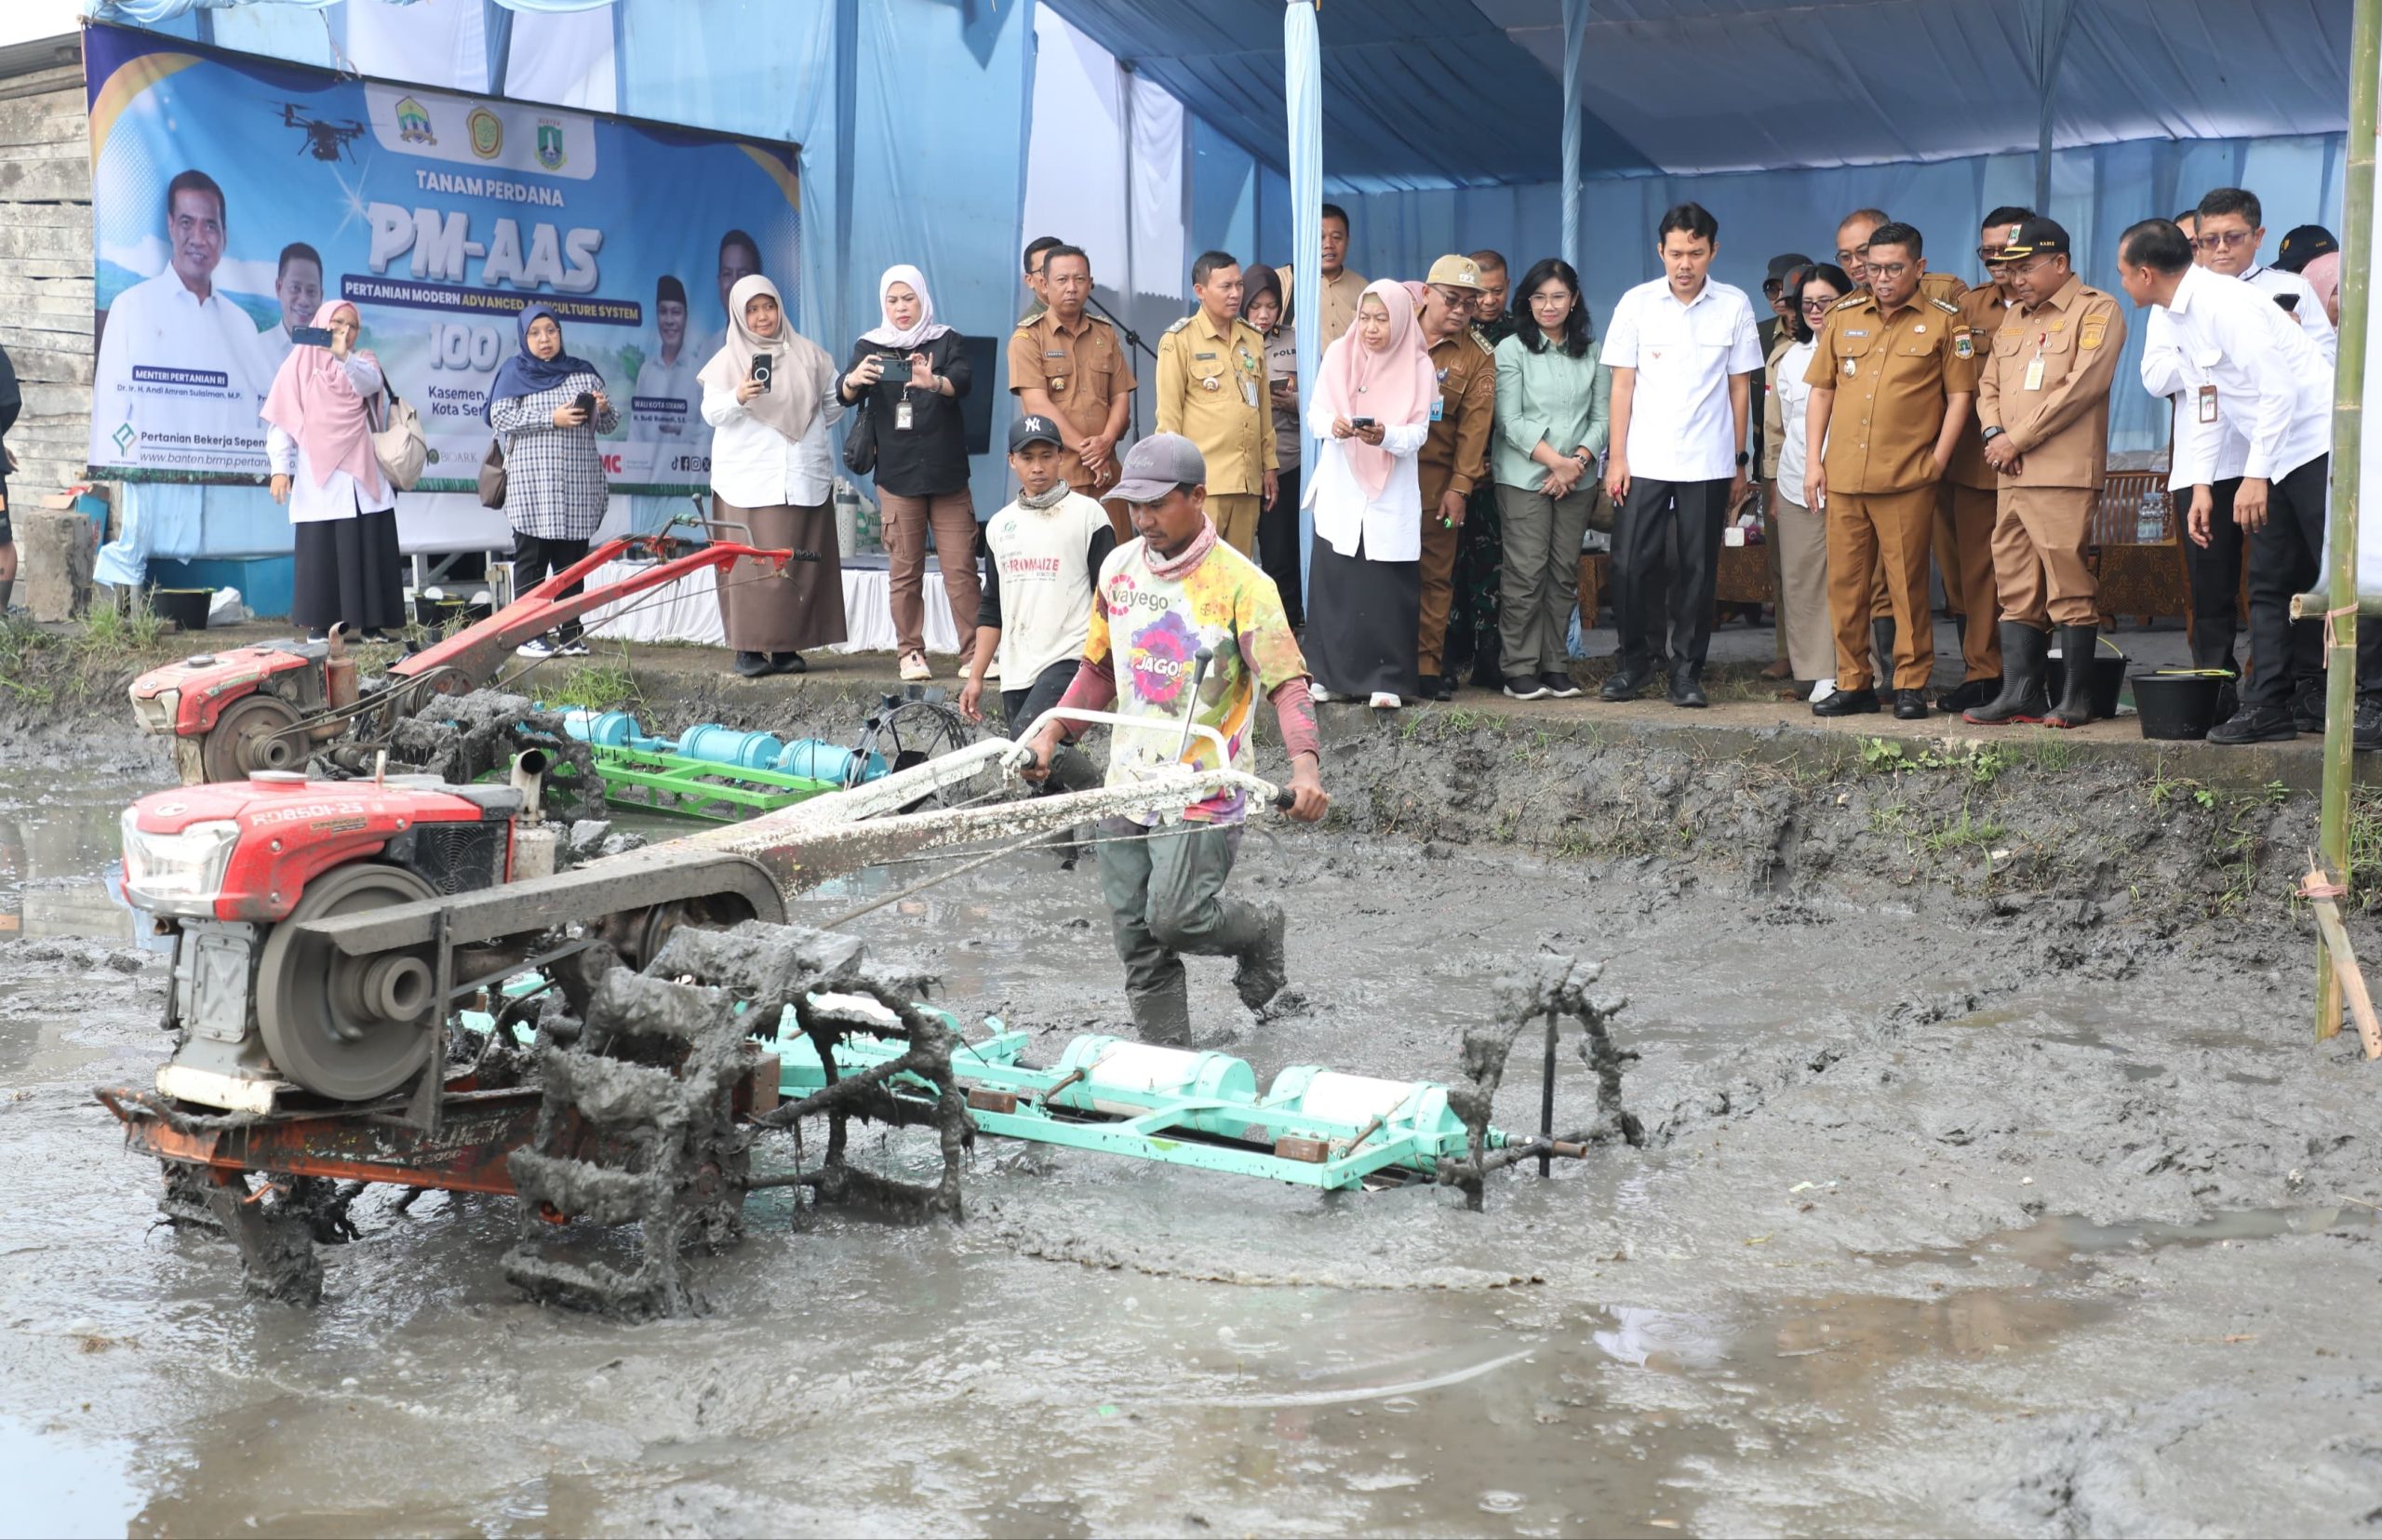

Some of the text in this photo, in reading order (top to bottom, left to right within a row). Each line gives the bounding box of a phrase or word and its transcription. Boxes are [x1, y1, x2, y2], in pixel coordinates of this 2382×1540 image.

[417, 169, 565, 208] TANAM PERDANA
[367, 201, 603, 293] PM-AAS
[345, 281, 410, 301] PERTANIAN
[412, 288, 461, 305] MODERN
[462, 293, 524, 310] ADVANCED
[598, 304, 638, 320] SYSTEM
[430, 324, 501, 371] 100
[1273, 348, 1297, 358] POLR
[135, 369, 225, 384] MENTERI PERTANIAN RI
[117, 383, 128, 392] Dr.
[146, 385, 164, 395] Andi
[165, 387, 188, 396] Amran
[432, 403, 483, 416] Kota Ser
[141, 432, 192, 444] Pertanian
[194, 434, 233, 448] Bekerja
[1112, 589, 1169, 611] vayego
[1136, 655, 1183, 678] JAGO!
